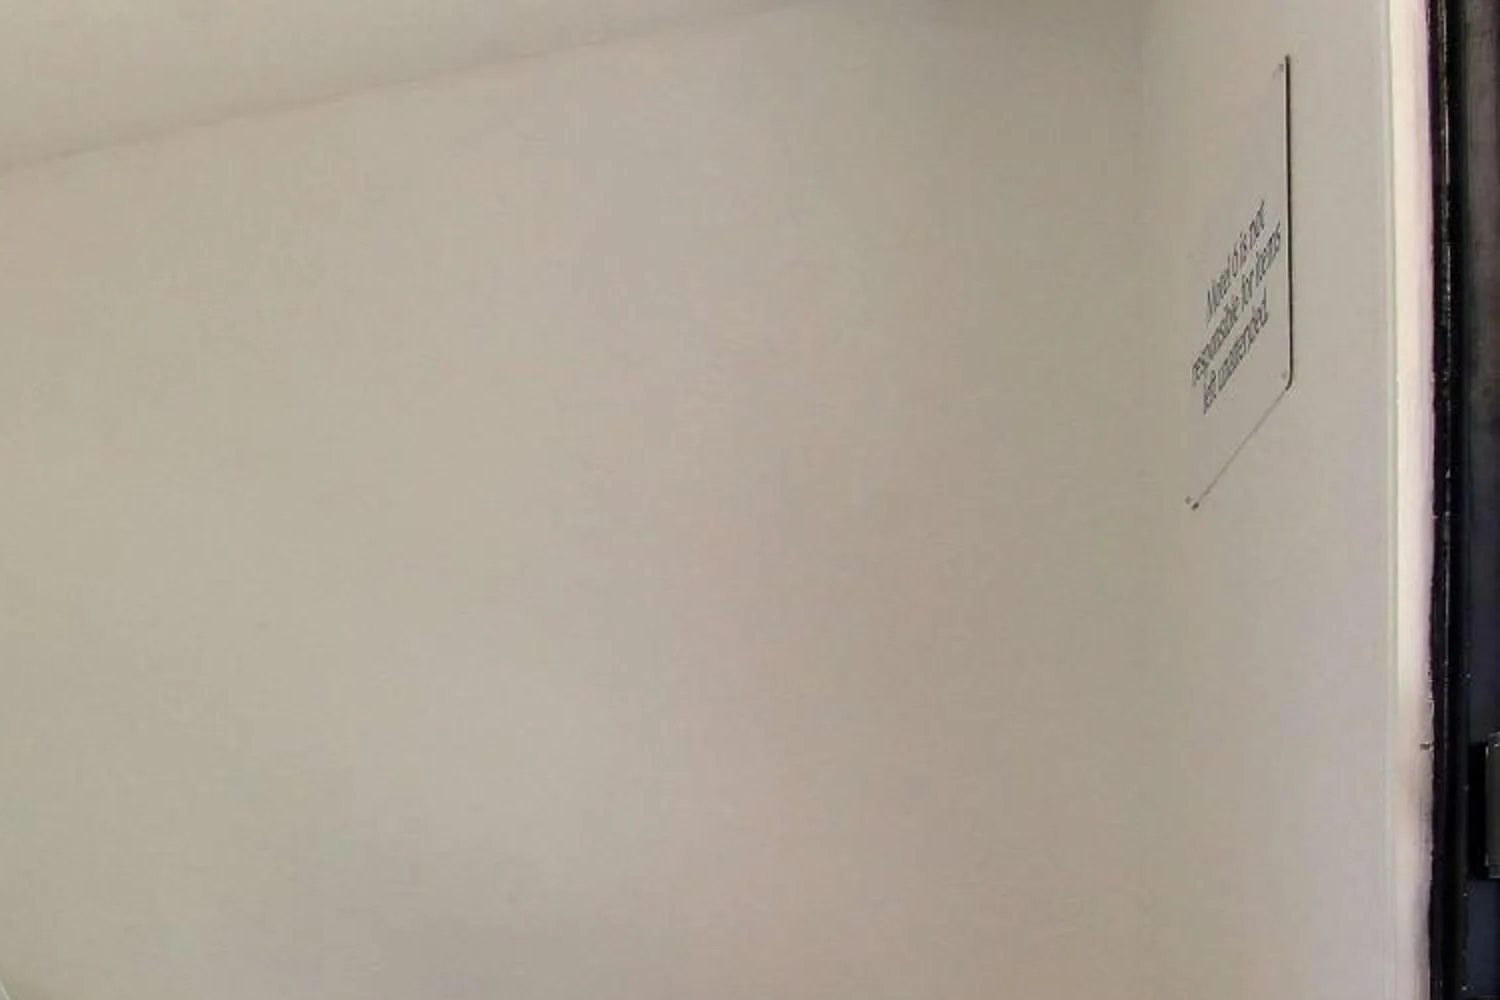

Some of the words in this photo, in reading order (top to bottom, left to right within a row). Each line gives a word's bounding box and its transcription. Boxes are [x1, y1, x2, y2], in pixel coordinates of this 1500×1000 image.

[1207, 254, 1231, 326] Motel
[1231, 245, 1239, 278] 6
[1239, 231, 1248, 268] is
[1249, 199, 1265, 250] not
[1241, 268, 1254, 313] for
[1255, 220, 1281, 288] items
